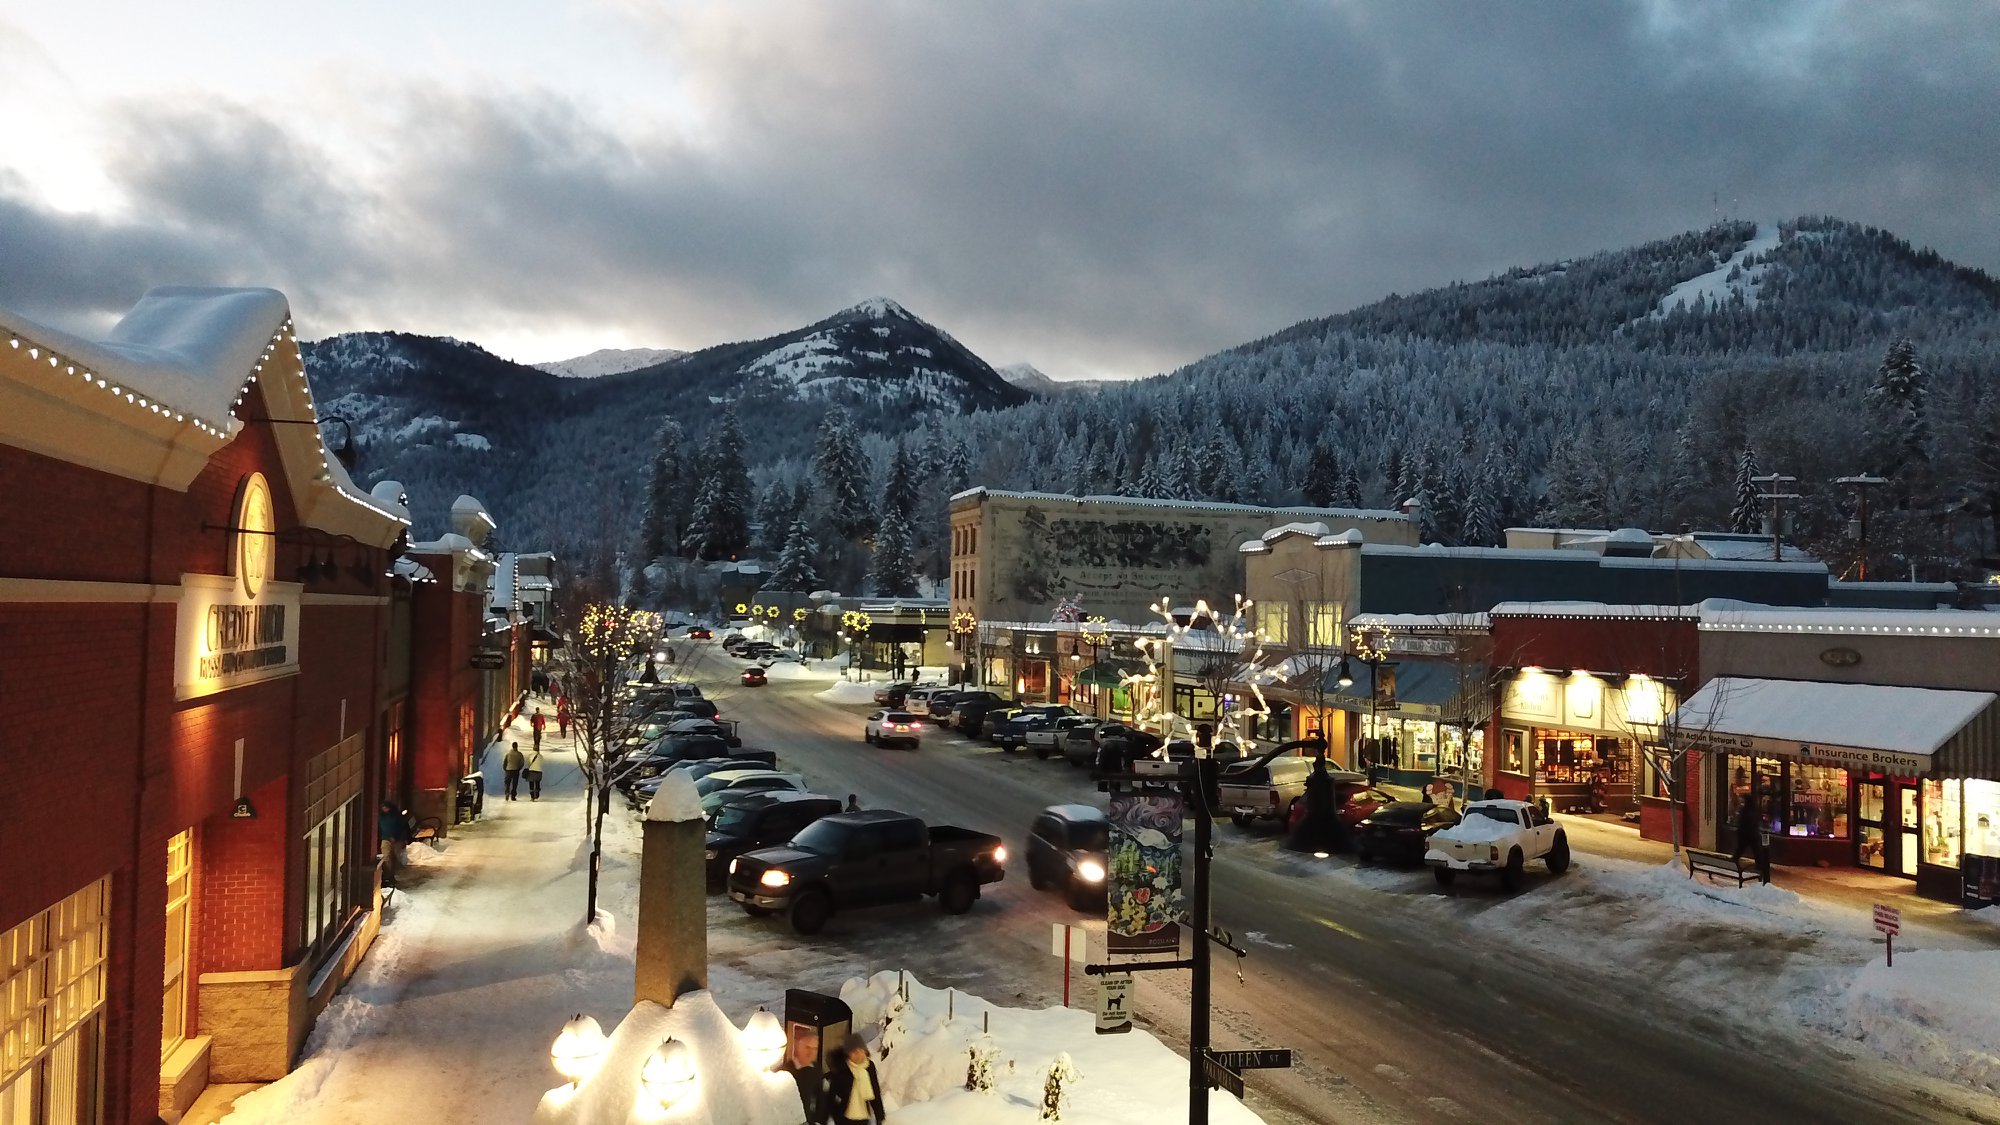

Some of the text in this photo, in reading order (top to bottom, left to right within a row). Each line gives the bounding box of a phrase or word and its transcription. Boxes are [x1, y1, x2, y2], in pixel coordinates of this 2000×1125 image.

[207, 604, 253, 652] CREDIT
[1709, 735, 1737, 745] Network
[1814, 746, 1918, 767] Insurance Brokers
[1219, 1052, 1280, 1068] QUEEN ST
